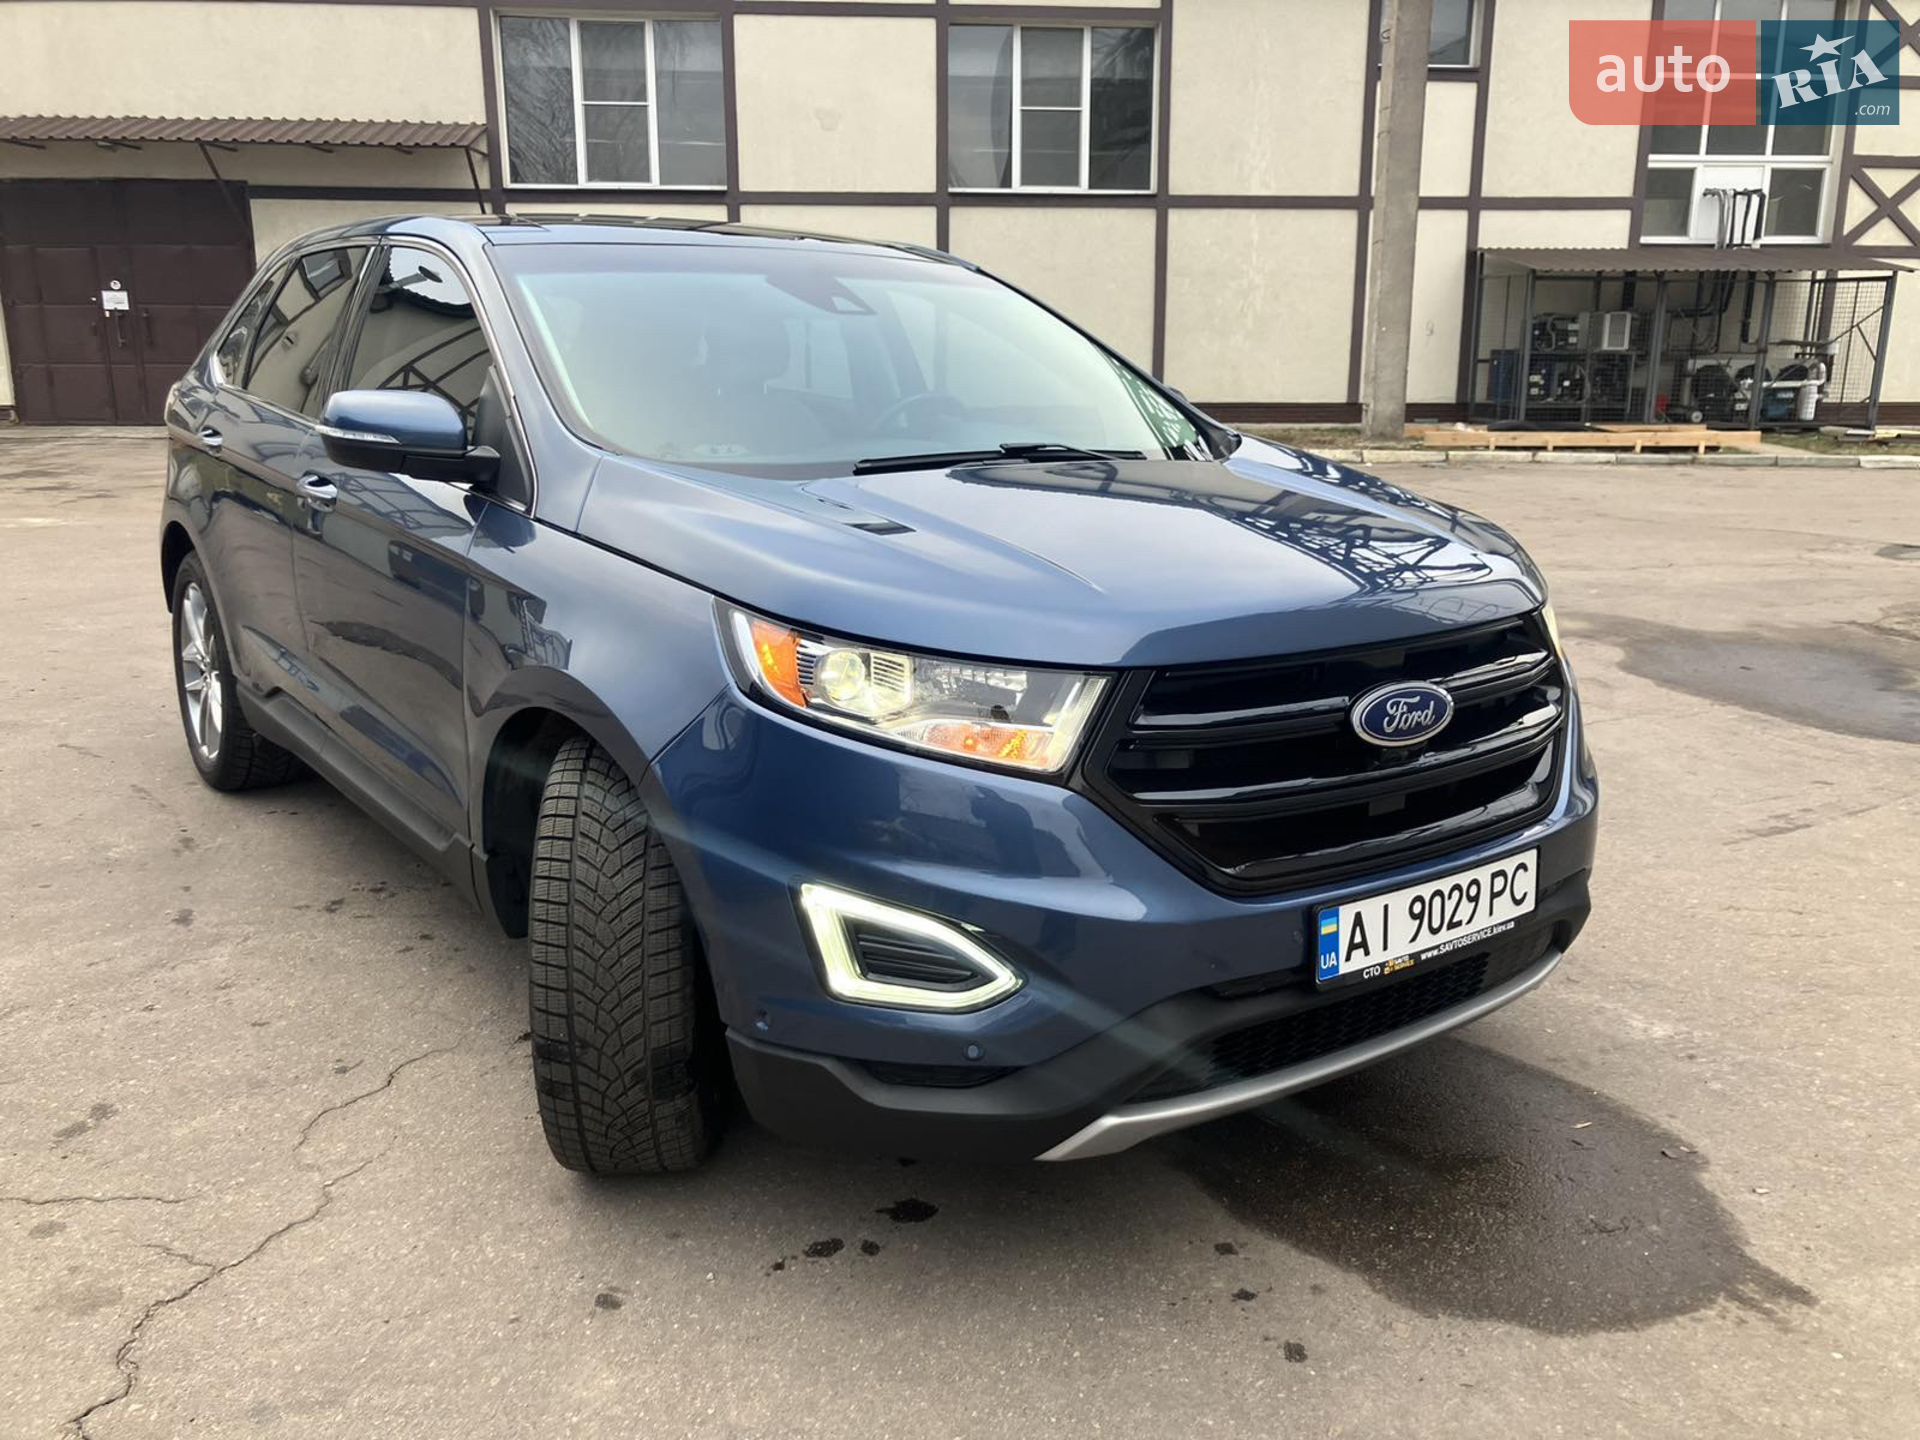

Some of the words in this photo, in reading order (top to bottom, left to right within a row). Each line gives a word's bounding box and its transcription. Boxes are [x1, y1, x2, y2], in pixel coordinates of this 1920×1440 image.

[1383, 695, 1436, 733] Ford
[1344, 903, 1390, 962] AI
[1408, 878, 1482, 944] 9029
[1488, 862, 1529, 917] PC
[1320, 952, 1338, 970] UA
